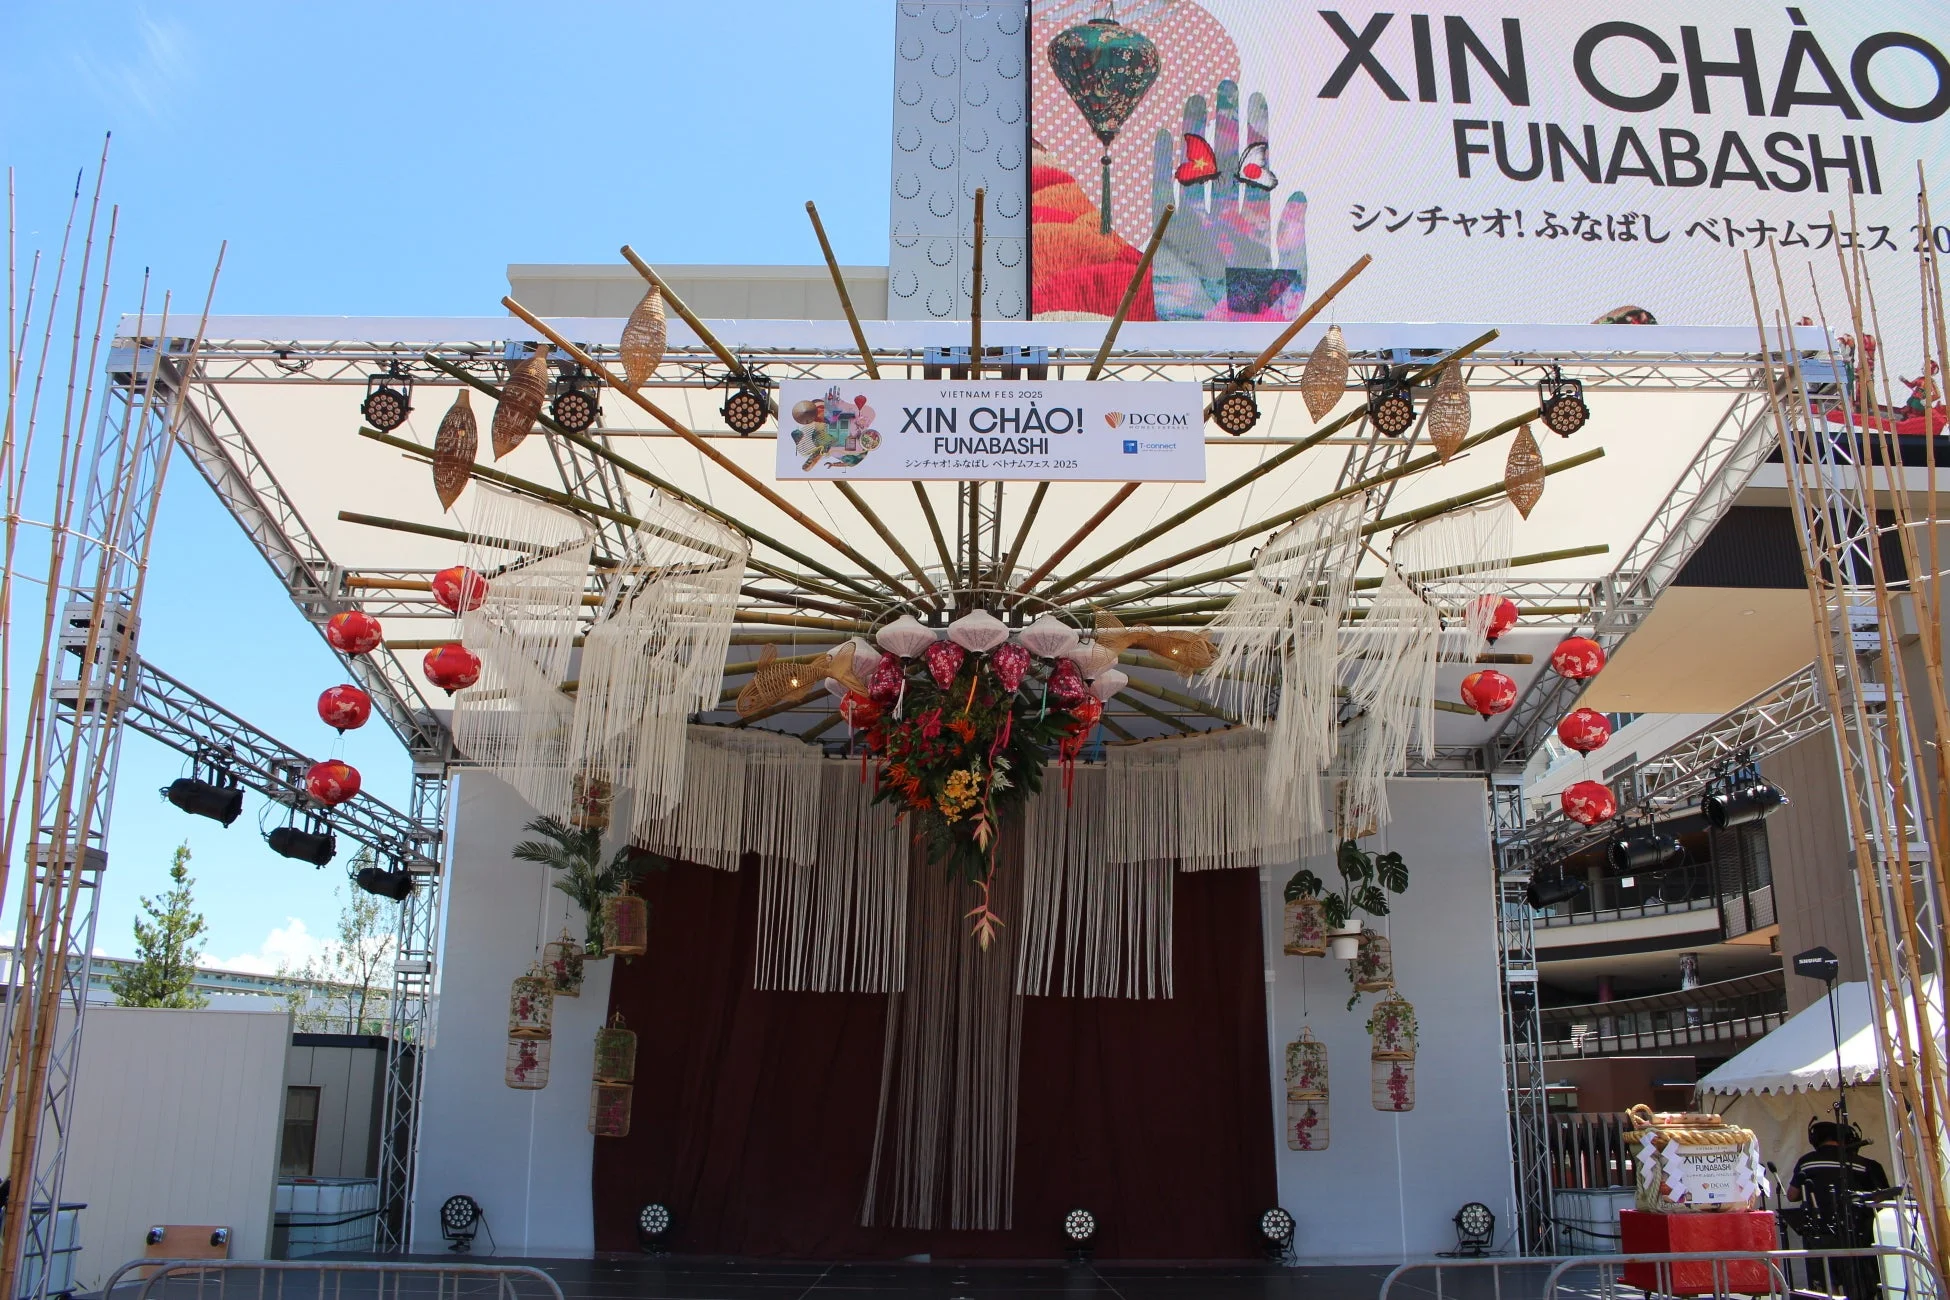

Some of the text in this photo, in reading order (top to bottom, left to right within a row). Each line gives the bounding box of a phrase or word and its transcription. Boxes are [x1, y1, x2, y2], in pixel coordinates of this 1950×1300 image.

[1317, 10, 1530, 106] XIN
[1452, 118, 1882, 196] FUNABASHI
[1535, 209, 1671, 244] ふなばし
[940, 390, 1043, 399] VIETNAM FES 2025
[900, 401, 1084, 435] XIN CHÀO!
[934, 437, 1049, 455] FUNABASHI
[953, 459, 989, 468] ふなばし
[1053, 460, 1078, 469] 2025
